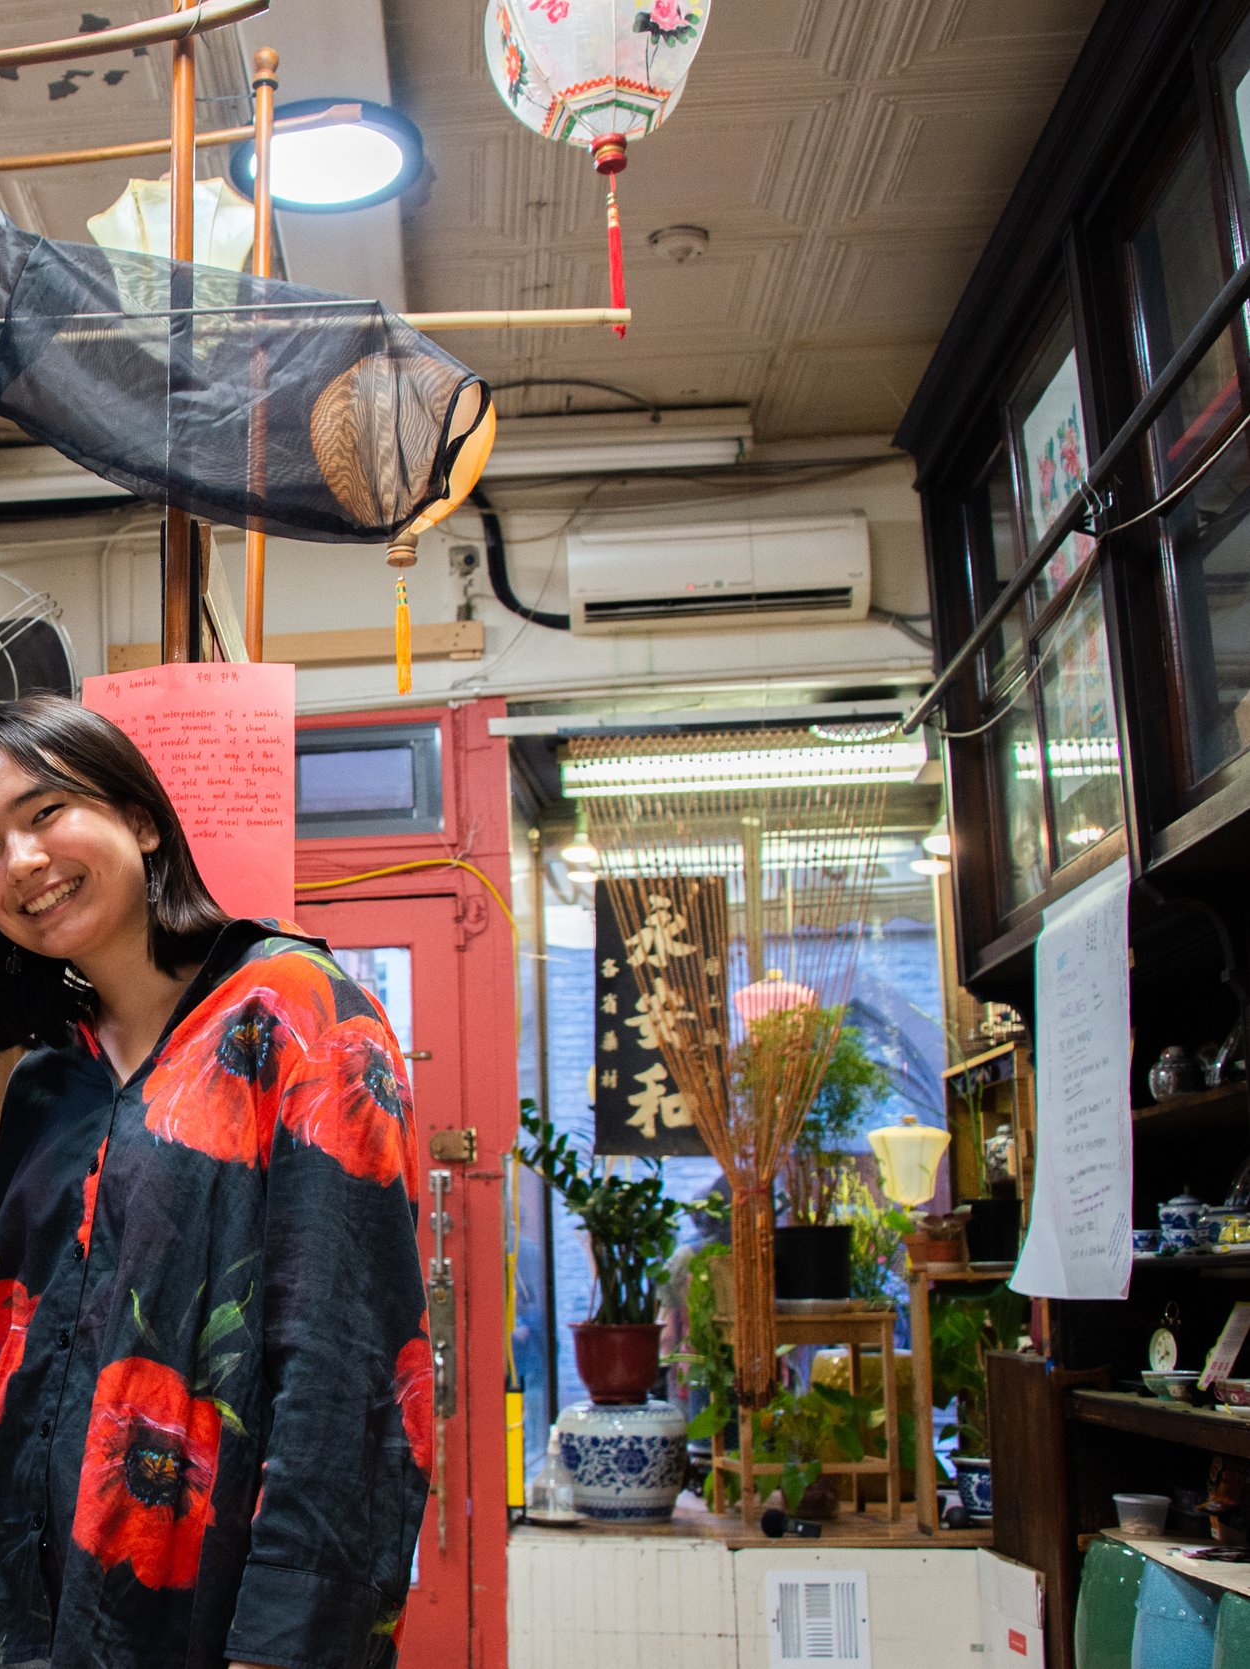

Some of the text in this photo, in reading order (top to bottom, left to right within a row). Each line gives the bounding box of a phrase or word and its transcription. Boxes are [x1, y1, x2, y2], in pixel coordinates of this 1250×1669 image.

[197, 671, 211, 683] 우리
[106, 676, 158, 697] My hanbok
[131, 716, 137, 724] is
[145, 715, 156, 724] my
[162, 710, 216, 721] interpretation
[225, 710, 233, 719] of
[147, 724, 171, 735] Korean
[225, 724, 238, 733] The
[246, 723, 267, 732] shawl
[160, 737, 189, 748] rounded
[198, 737, 221, 745] sleeves
[229, 737, 237, 745] of
[171, 752, 202, 761] stitched
[224, 752, 240, 764] map
[247, 751, 254, 760] of
[262, 751, 274, 759] the
[171, 765, 187, 775] City
[229, 764, 247, 772] often
[251, 764, 283, 776] frequent,
[181, 778, 198, 790] gold
[207, 778, 235, 786] thread.
[244, 778, 257, 787] The
[213, 792, 226, 800] and
[234, 792, 259, 803] finding
[265, 792, 281, 800] one's
[260, 805, 278, 814] stars
[194, 818, 209, 826] and
[217, 818, 240, 827] reveal
[246, 818, 284, 827] themselves
[192, 831, 235, 839] walked in.
